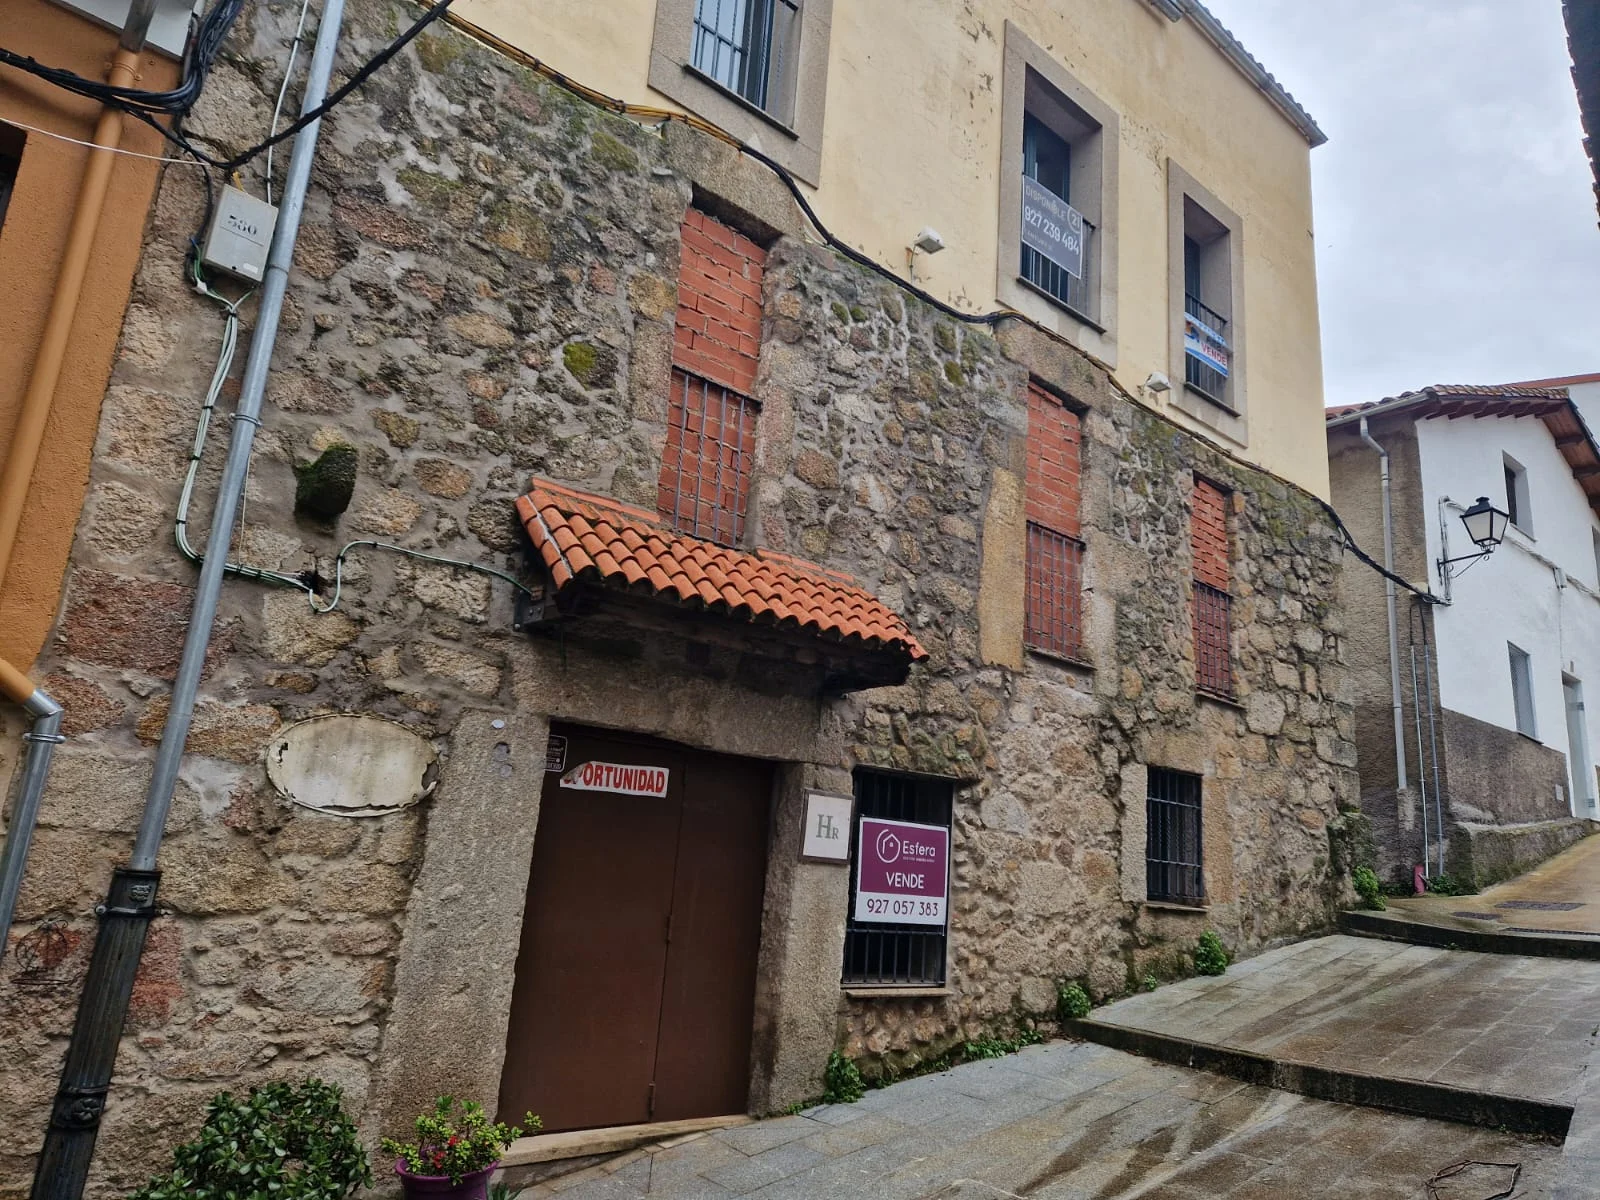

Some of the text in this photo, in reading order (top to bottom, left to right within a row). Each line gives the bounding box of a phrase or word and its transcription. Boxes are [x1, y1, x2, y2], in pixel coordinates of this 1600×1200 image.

[1062, 232, 1079, 255] 484
[563, 762, 665, 793] ORTUNIDAD
[902, 841, 936, 857] Esfera
[886, 872, 925, 889] VENDE
[867, 898, 938, 917] 927 057 383
